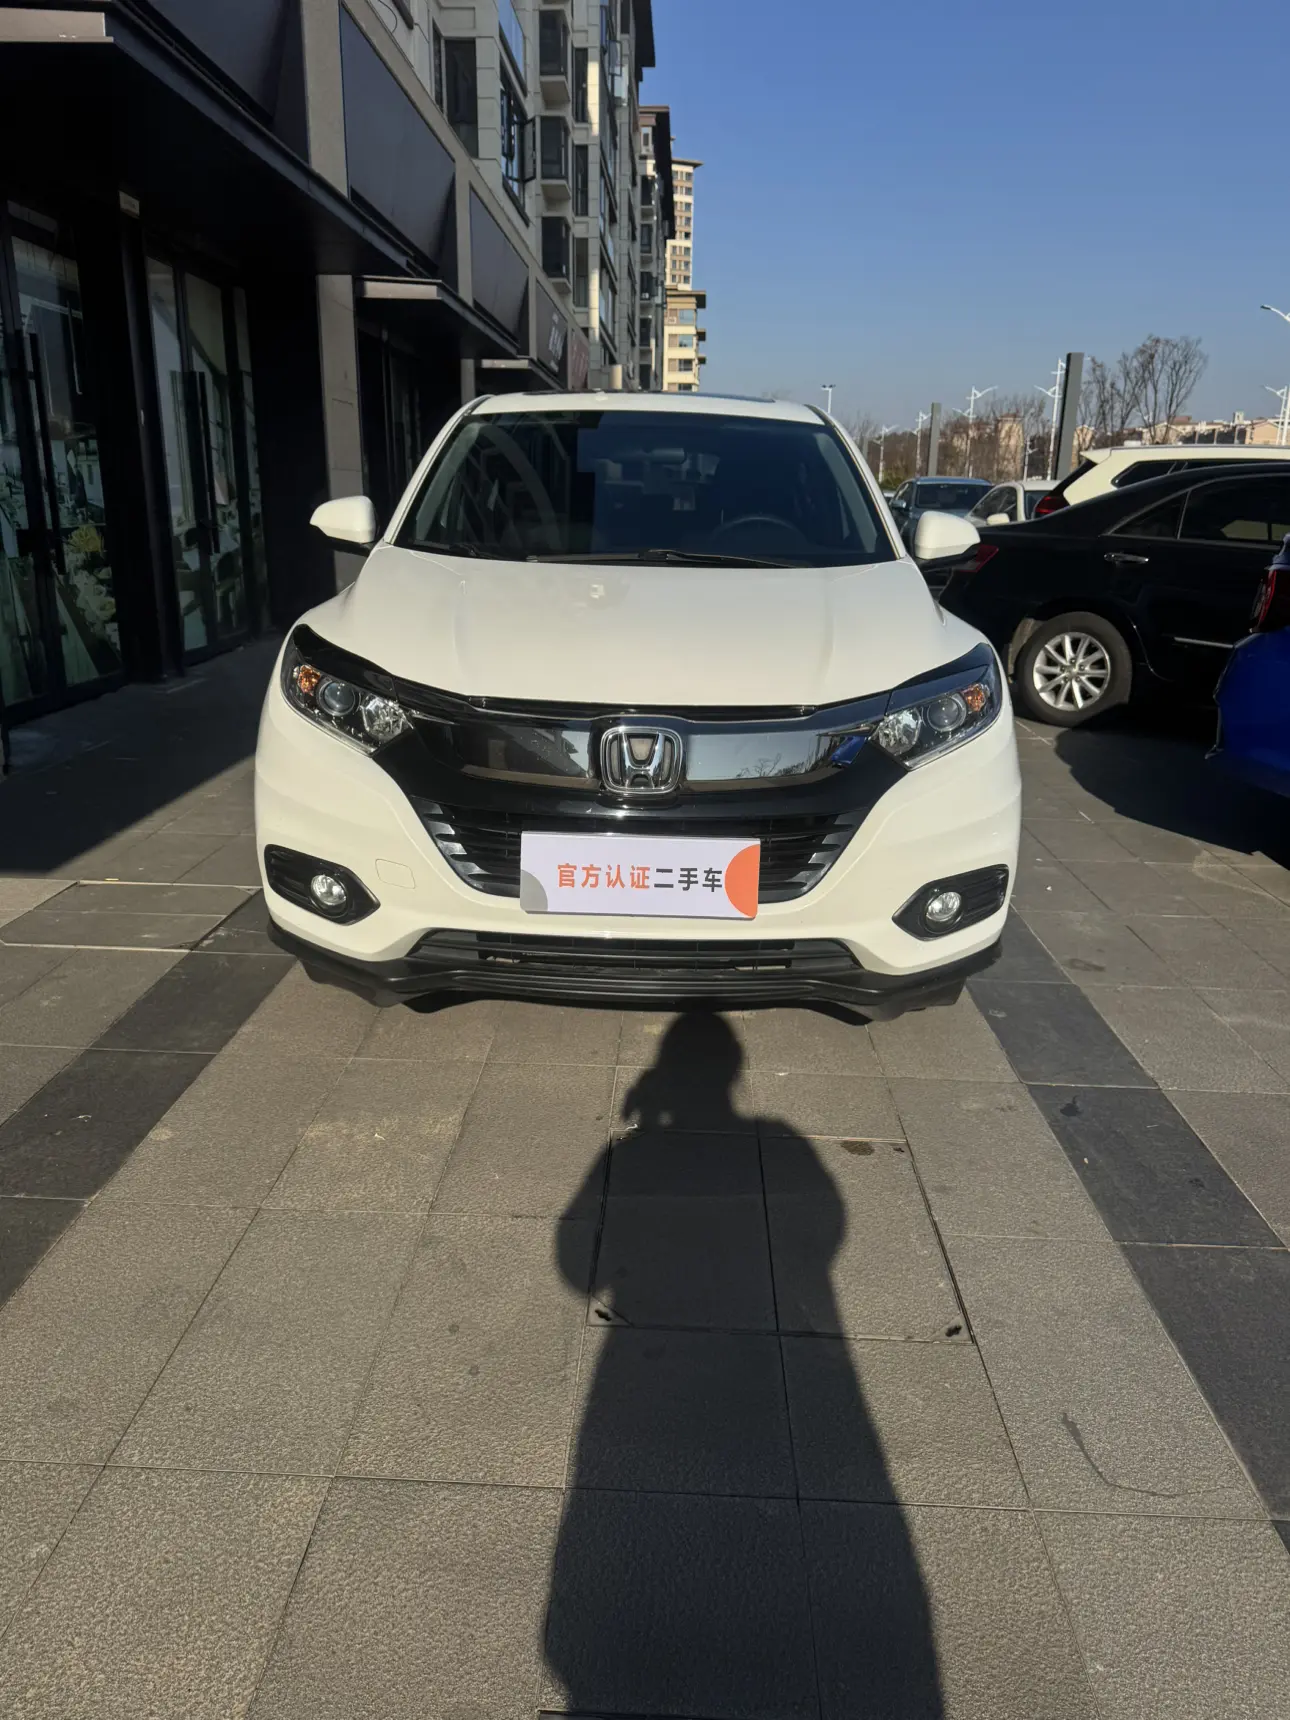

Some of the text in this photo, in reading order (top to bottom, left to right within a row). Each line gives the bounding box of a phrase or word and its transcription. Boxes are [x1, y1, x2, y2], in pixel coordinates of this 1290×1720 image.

[557, 863, 723, 892] 官方认证二手车
